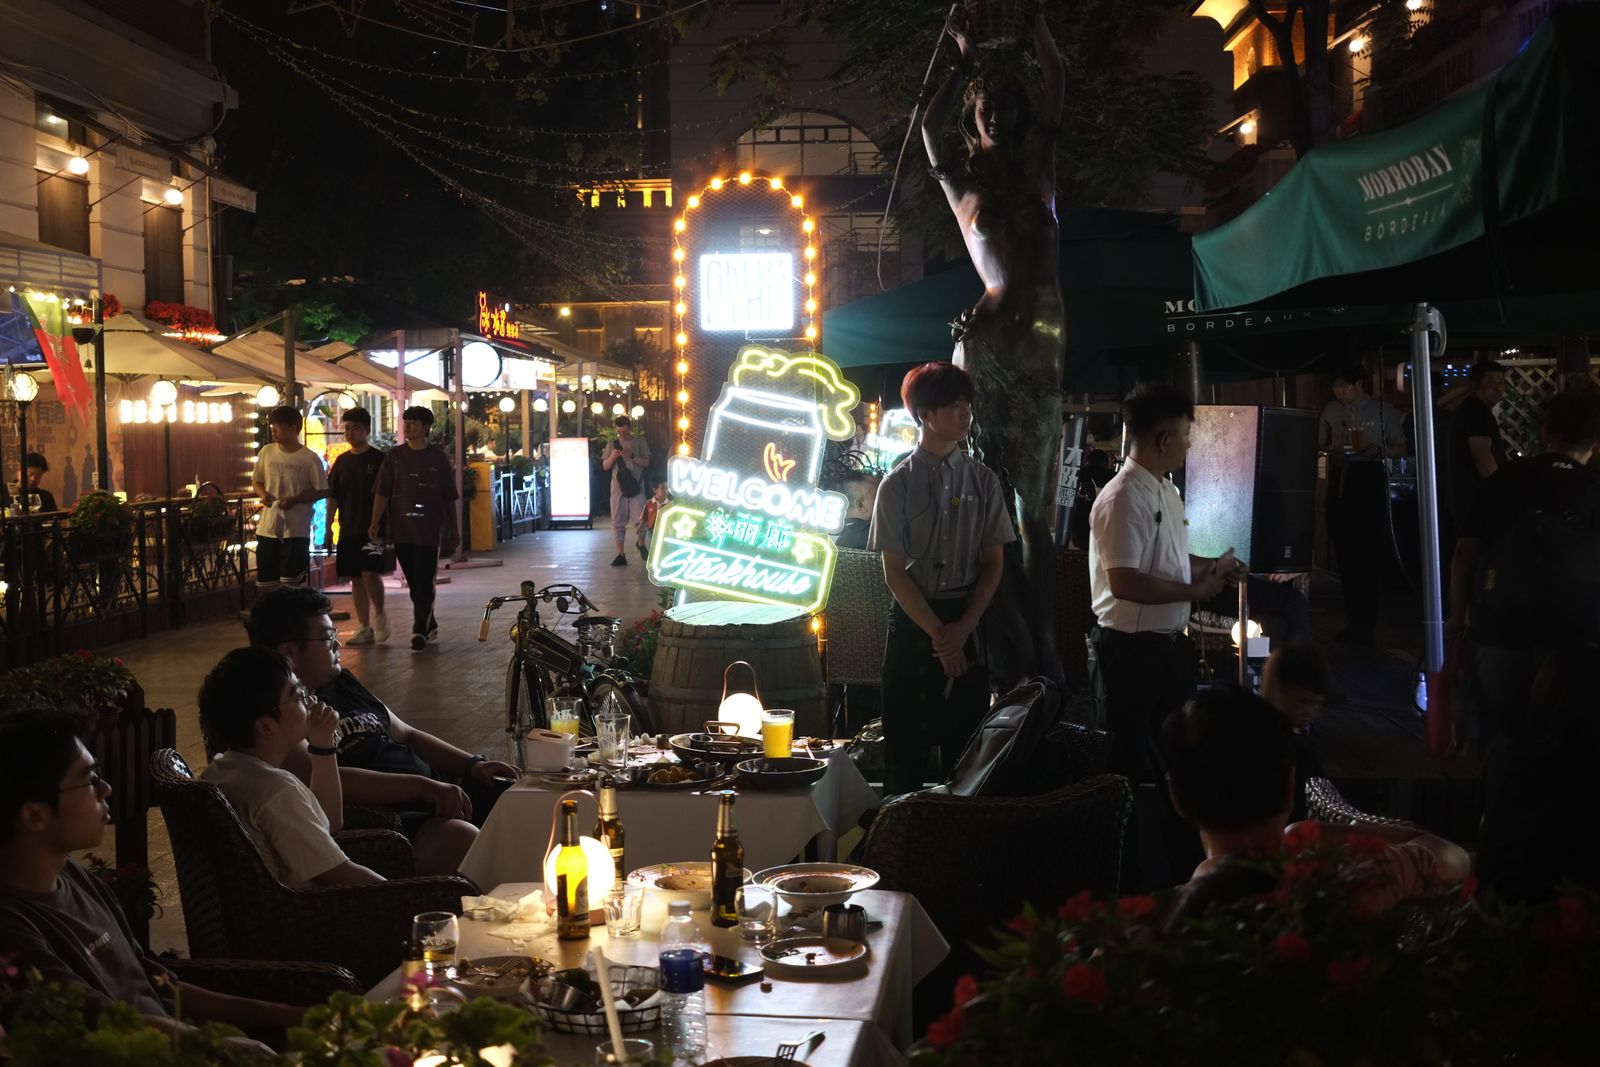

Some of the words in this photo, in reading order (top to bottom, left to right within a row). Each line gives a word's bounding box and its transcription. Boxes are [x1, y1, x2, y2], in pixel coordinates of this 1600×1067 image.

[1357, 143, 1453, 202] MORROBAY
[1167, 311, 1312, 333] BORDEAUX
[672, 459, 845, 530] WELCOME
[654, 547, 813, 595] Steakhouse
